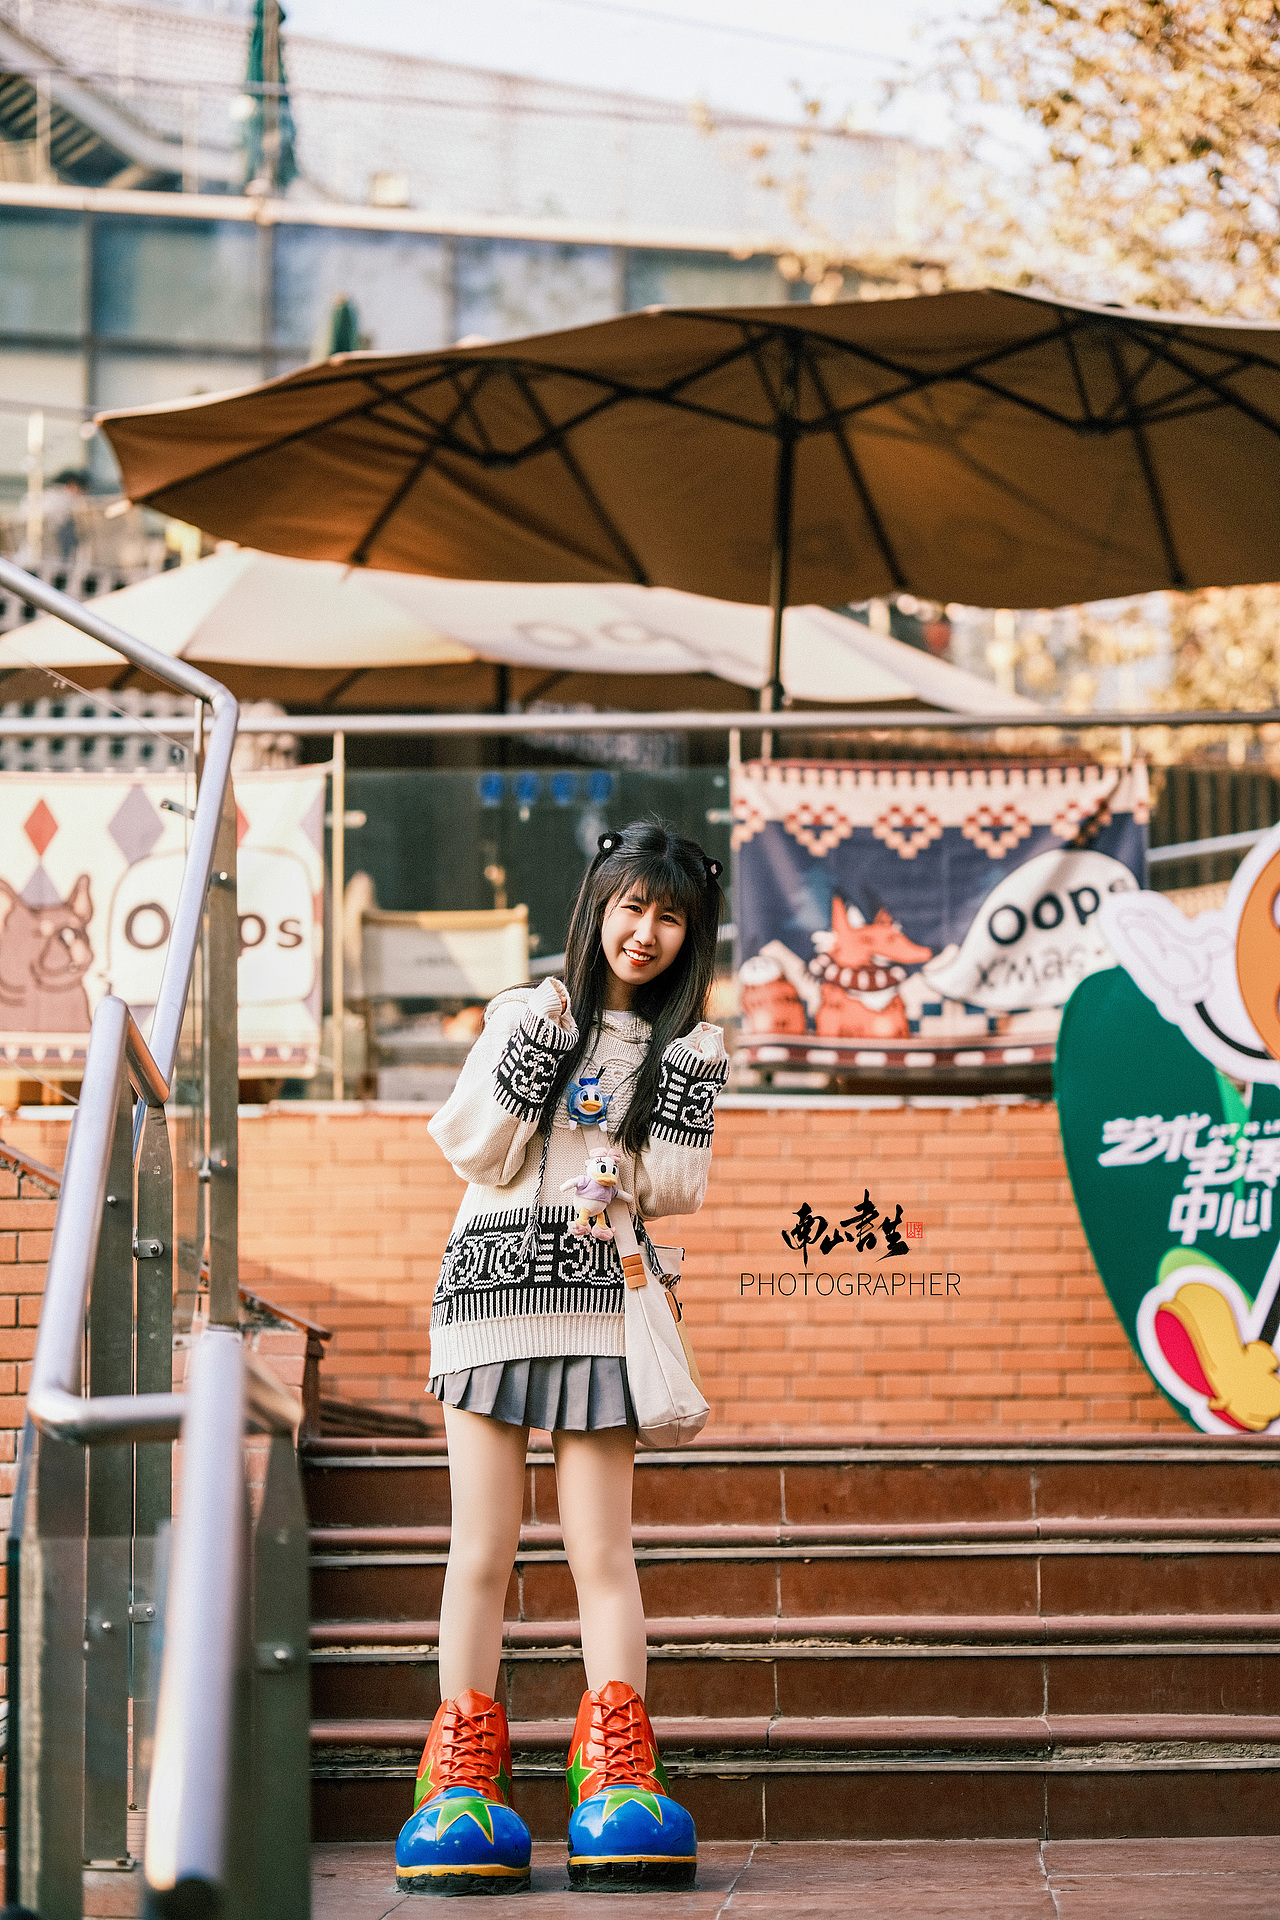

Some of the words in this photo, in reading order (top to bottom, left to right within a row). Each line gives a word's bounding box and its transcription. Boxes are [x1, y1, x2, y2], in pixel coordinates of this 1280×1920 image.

[125, 902, 304, 957] Ops
[1098, 1112, 1211, 1167] 艺术
[1183, 1137, 1280, 1189] 生活
[1168, 1187, 1272, 1245] 中心
